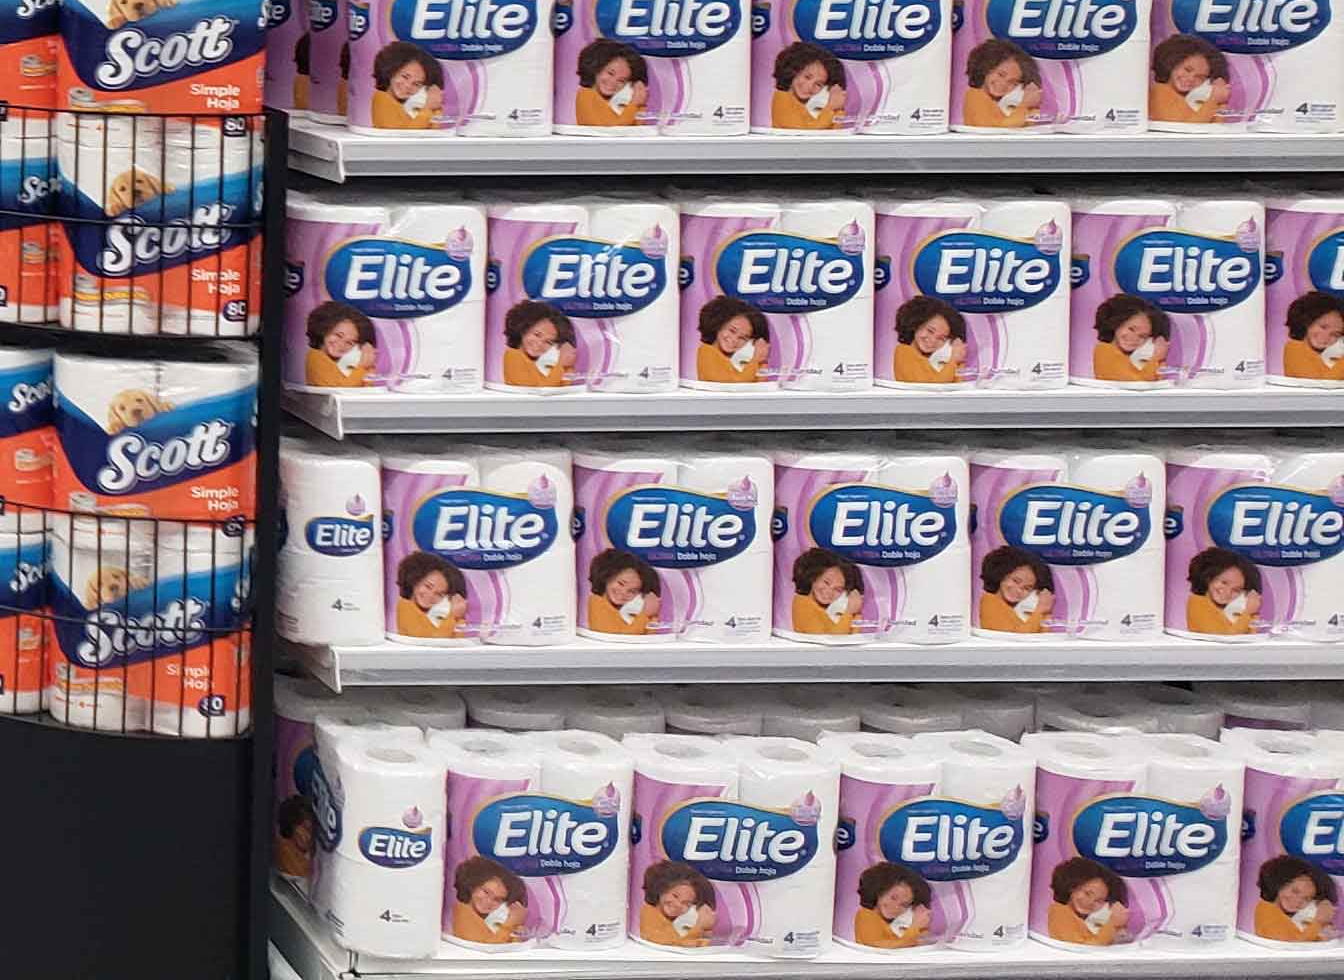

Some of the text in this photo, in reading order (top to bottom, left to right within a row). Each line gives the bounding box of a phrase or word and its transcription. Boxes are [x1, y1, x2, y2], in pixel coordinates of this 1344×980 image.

[96, 16, 234, 89] Scott
[190, 83, 241, 99] Simple
[206, 97, 241, 112] Hoja
[344, 254, 462, 303] Elite
[736, 248, 855, 297] Elite
[1140, 246, 1254, 294] Elite
[100, 420, 232, 493] Scott
[190, 485, 240, 501] Simple
[206, 498, 240, 513] Hoja
[315, 522, 369, 548] Elite
[433, 505, 545, 551] Elite
[1232, 500, 1344, 547] Elite
[368, 832, 426, 860] Elite
[493, 810, 609, 858] Elite
[682, 815, 807, 864] Elite
